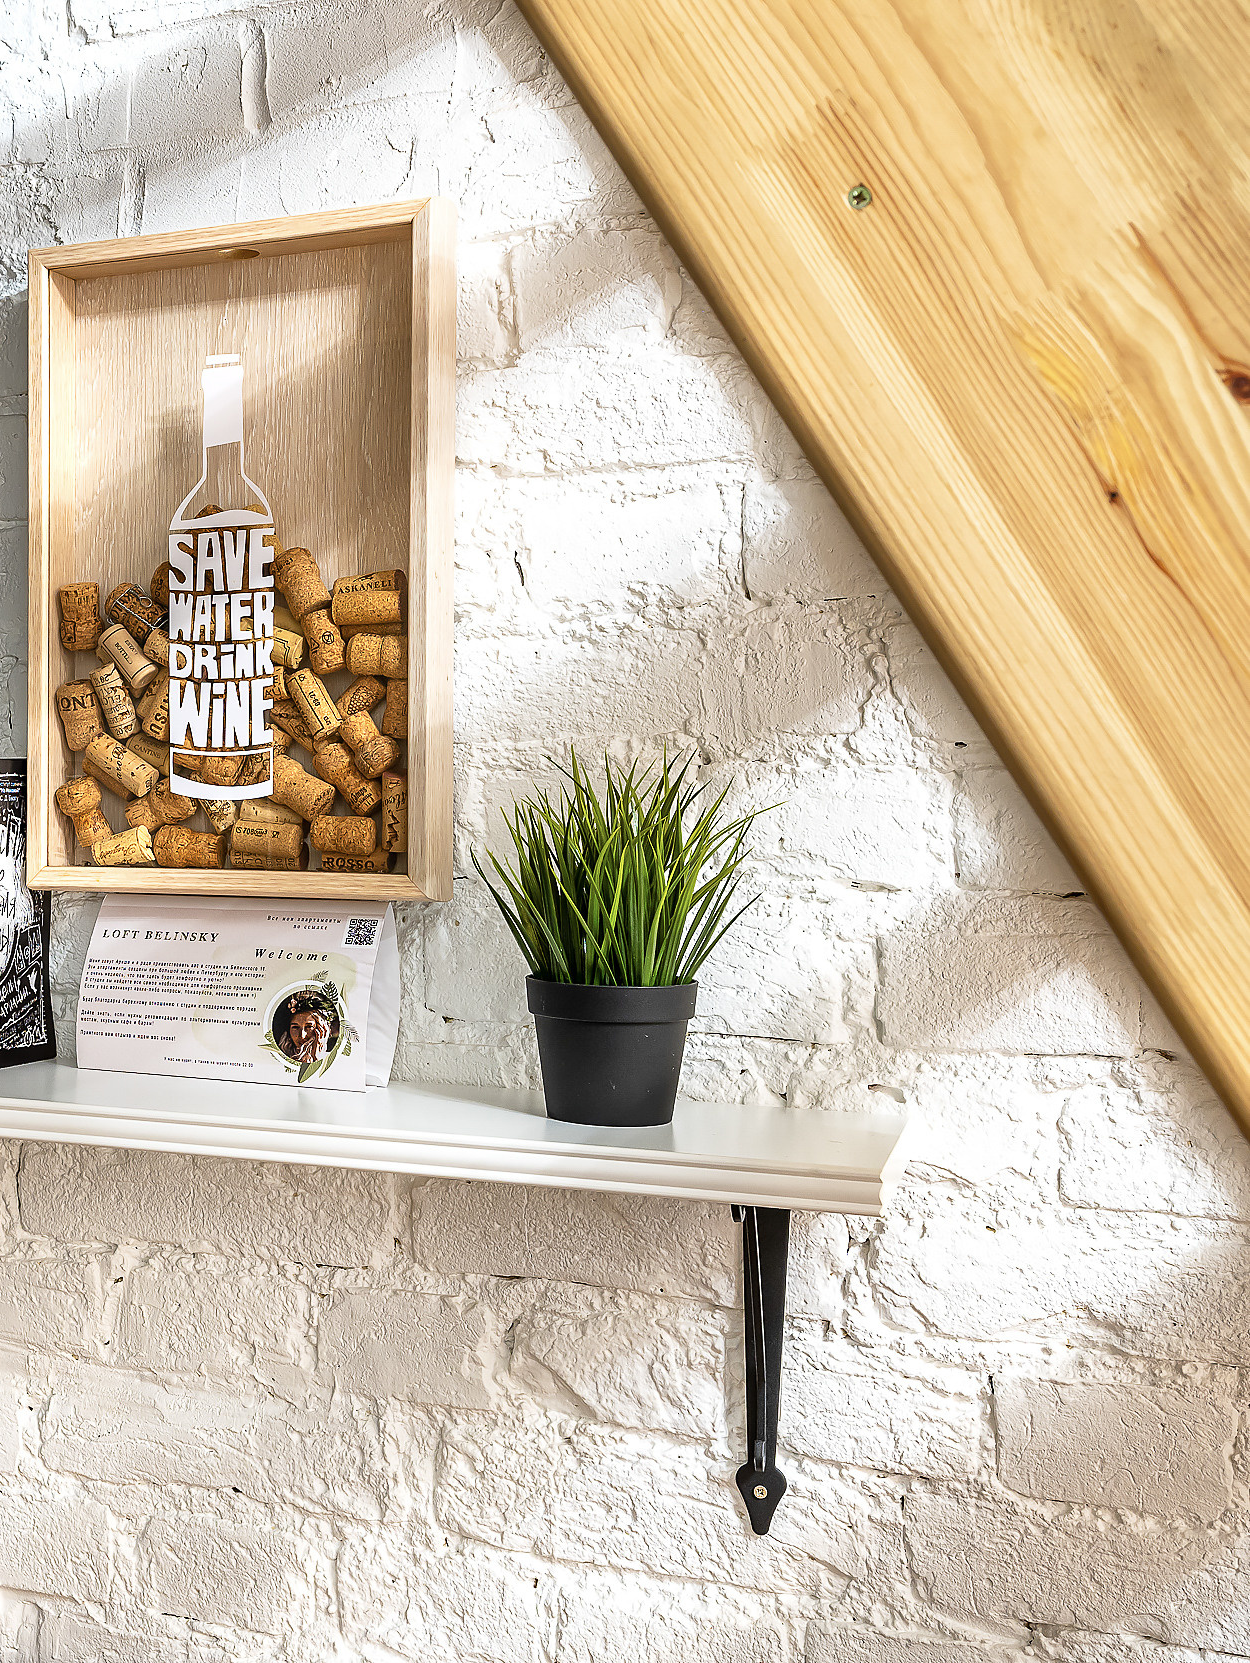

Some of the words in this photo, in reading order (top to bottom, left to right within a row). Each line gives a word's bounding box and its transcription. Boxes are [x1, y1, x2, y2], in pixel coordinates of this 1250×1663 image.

[168, 528, 275, 592] SAVE
[337, 579, 392, 595] ASKANELI
[168, 591, 275, 642] WATER
[322, 857, 375, 871] ROSSO
[297, 916, 341, 924] апартаменты
[103, 929, 140, 939] LOFT
[145, 930, 220, 942] BELINSKY
[255, 948, 328, 961] Welcome
